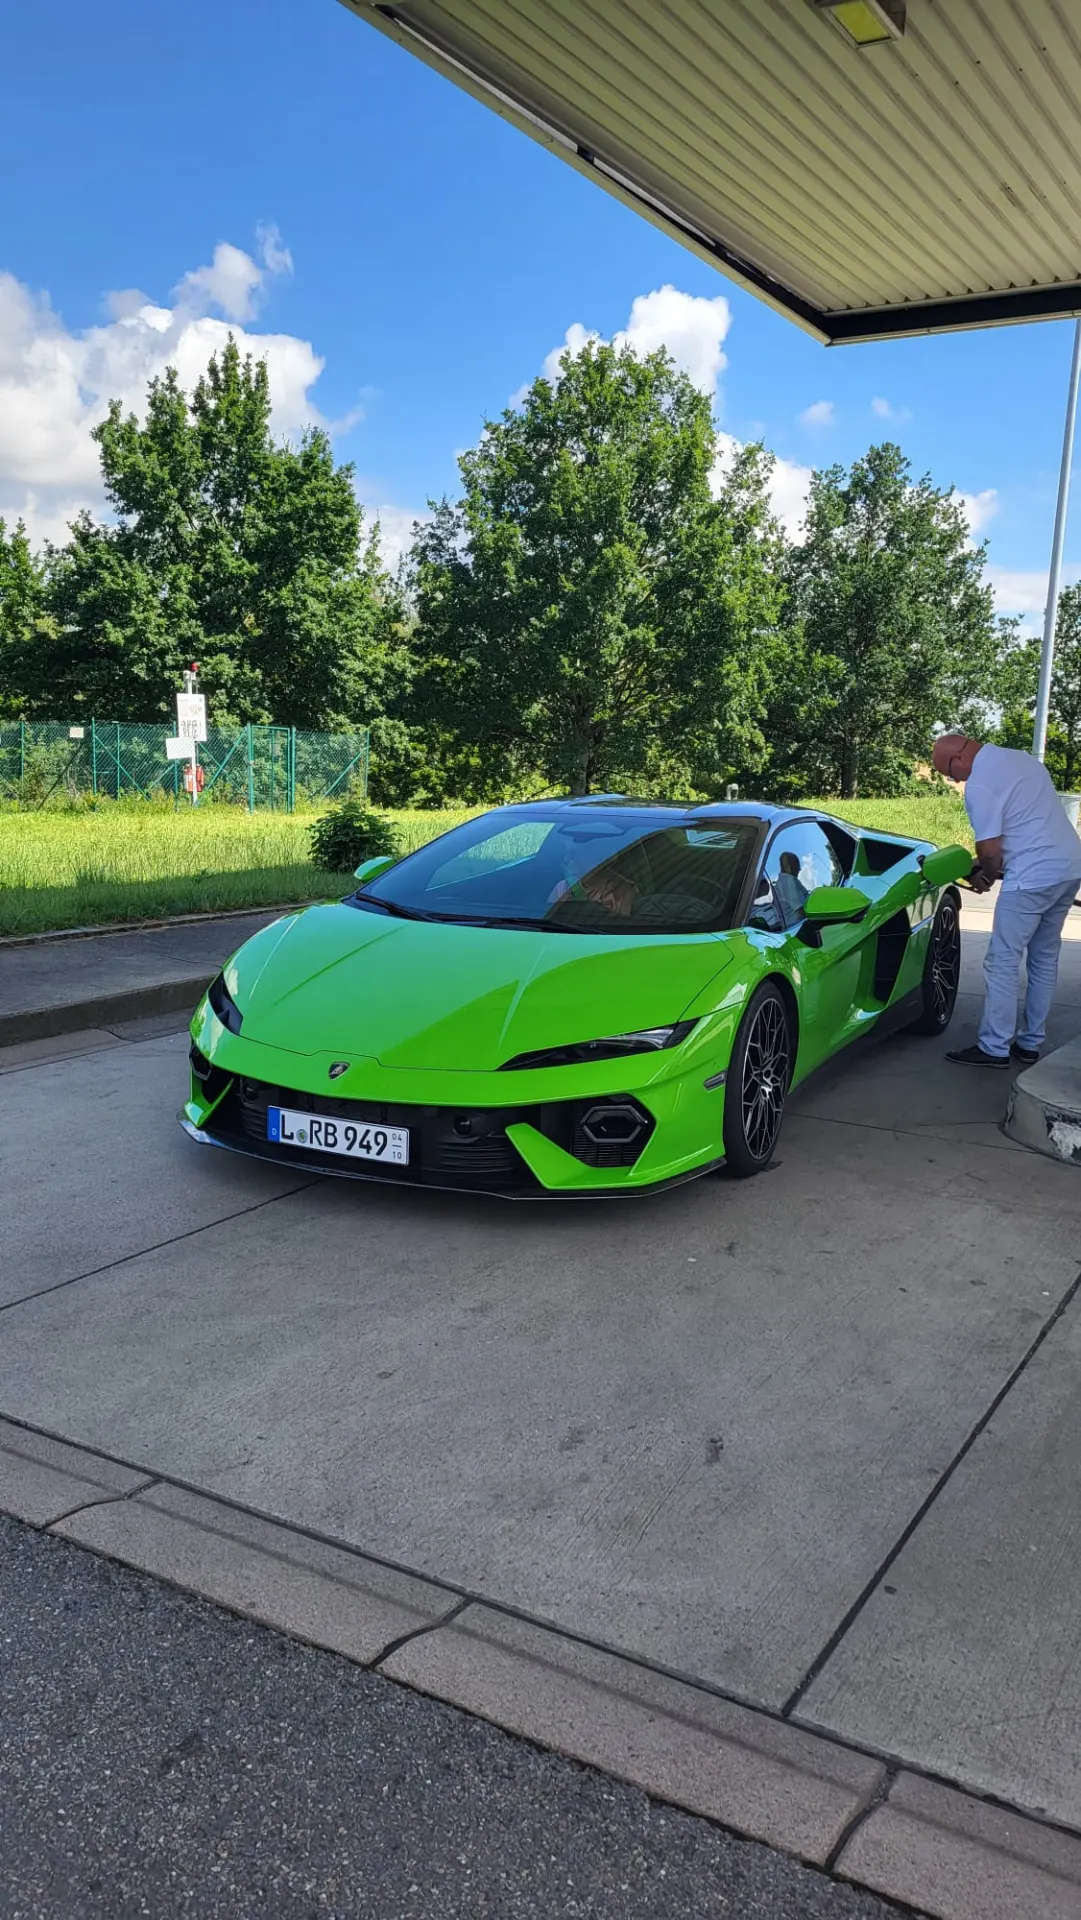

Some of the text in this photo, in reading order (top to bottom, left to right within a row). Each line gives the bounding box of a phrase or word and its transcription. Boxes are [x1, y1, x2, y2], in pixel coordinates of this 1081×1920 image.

[271, 1128, 277, 1136] D
[281, 1114, 388, 1157] L RB 949
[392, 1132, 402, 1142] 04
[392, 1151, 402, 1160] 10
